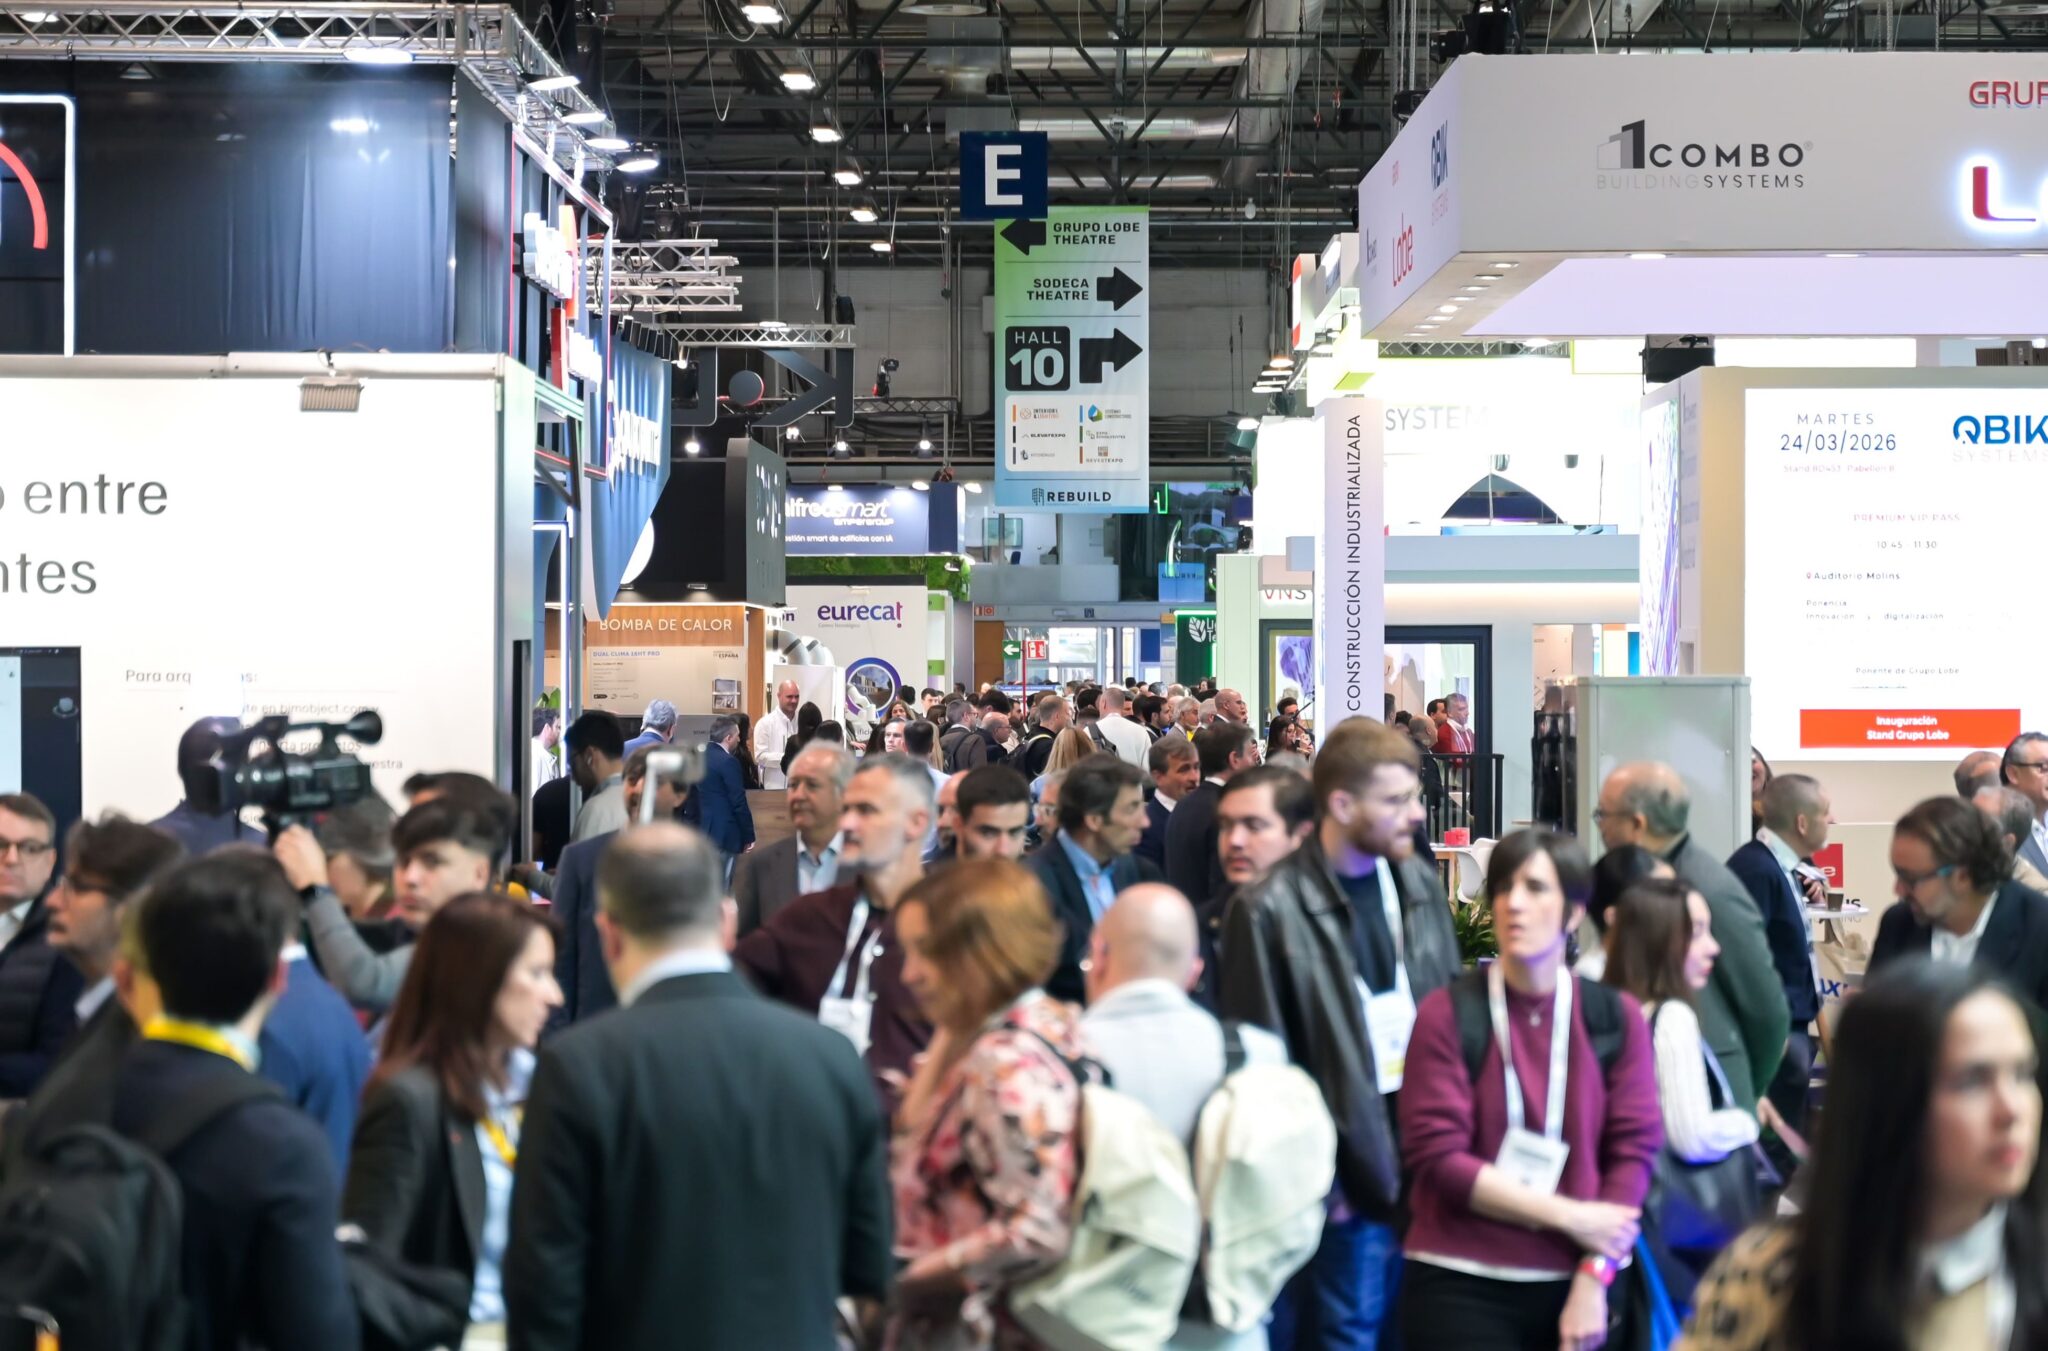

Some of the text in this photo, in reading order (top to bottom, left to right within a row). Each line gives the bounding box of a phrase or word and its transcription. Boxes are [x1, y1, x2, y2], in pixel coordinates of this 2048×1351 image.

[1649, 143, 1804, 168] COMBO
[985, 145, 1023, 206] E
[1972, 166, 2048, 222] L
[1053, 222, 1141, 233] GRUPO LOBE
[1053, 235, 1116, 245] THEATRE
[1033, 278, 1090, 289] SODECA
[1027, 290, 1090, 301] THEATRE
[1014, 331, 1062, 345] HALL
[1009, 347, 1064, 386] 10
[1797, 413, 1875, 425] MARTES
[1780, 430, 1897, 454] 24/03/2026
[23, 473, 168, 515] entre
[1047, 491, 1112, 502] REBUILD
[806, 534, 828, 543] smart
[829, 534, 838, 543] de
[840, 534, 869, 543] edificios
[870, 535, 884, 543] con
[1343, 415, 1361, 711] CONSTRUCCIÓN INDUSTRIALIZADA
[1866, 571, 1901, 580] Molins
[817, 601, 903, 628] eurecat
[600, 618, 732, 631] BOMBA DE CALOR
[125, 669, 161, 683] Para
[1876, 716, 1938, 727] Inauguración
[1866, 730, 1950, 741] Stand Grupo Lobe
